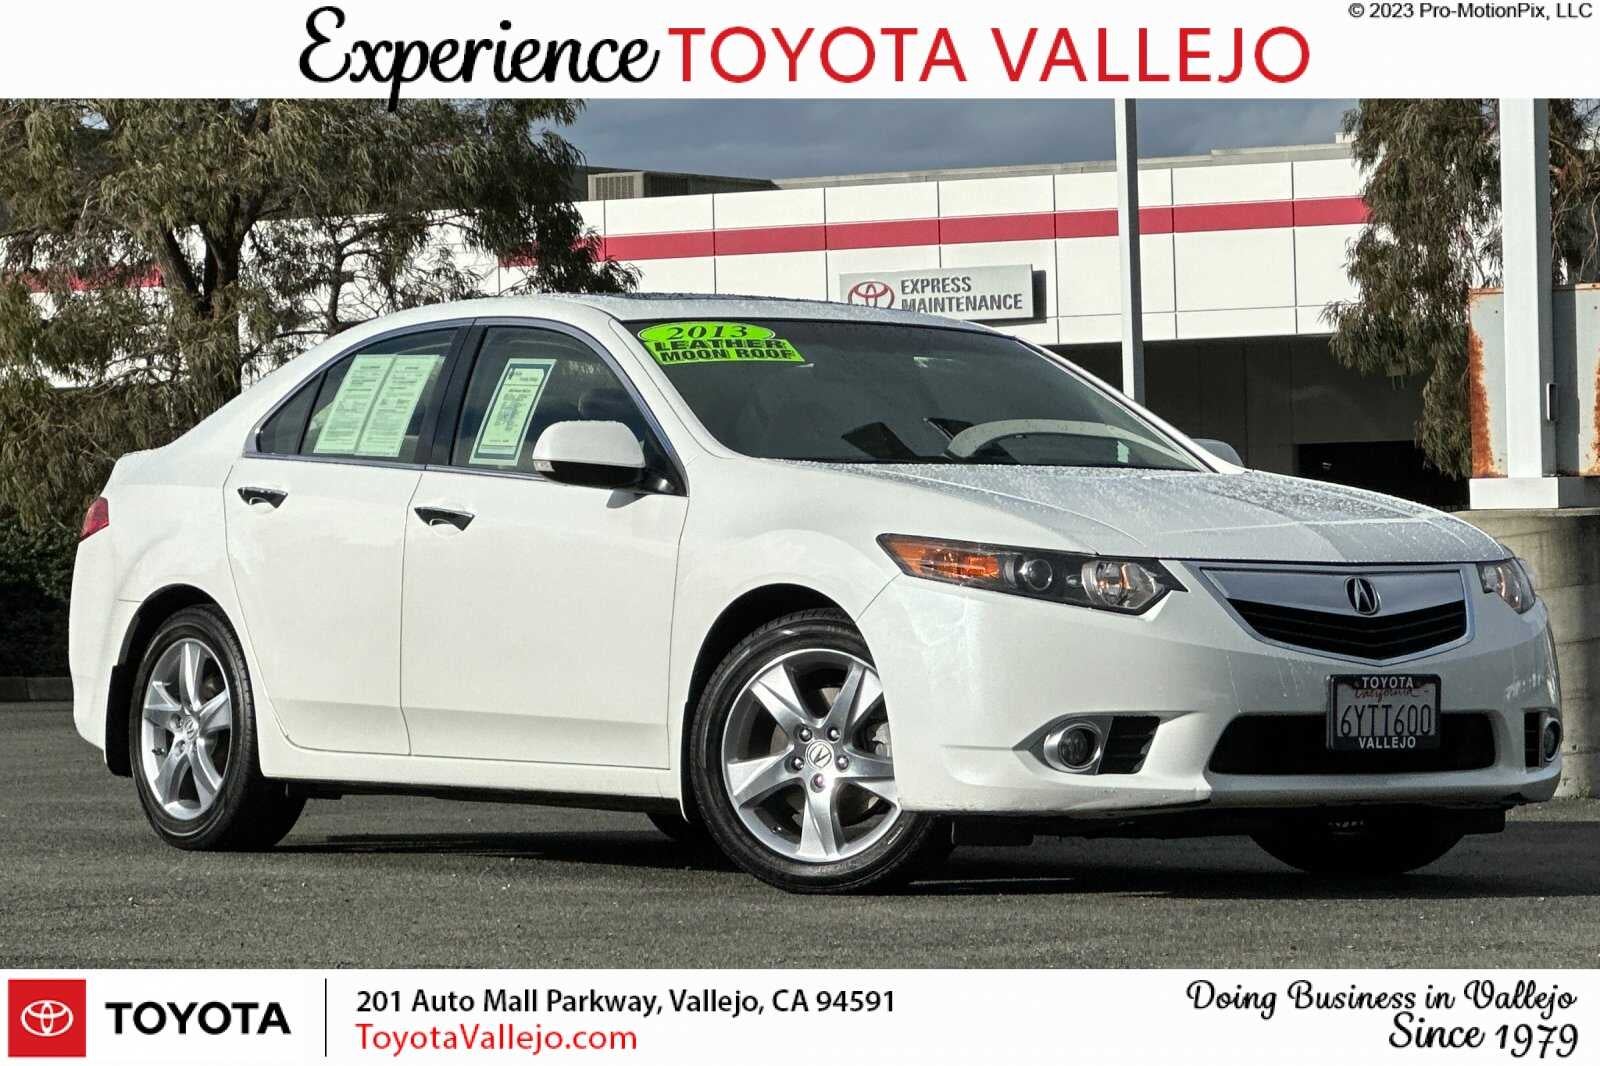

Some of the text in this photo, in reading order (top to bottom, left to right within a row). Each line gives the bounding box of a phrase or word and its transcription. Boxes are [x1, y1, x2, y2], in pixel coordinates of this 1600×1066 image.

[900, 276, 972, 295] EXPRESS
[901, 293, 1023, 313] MAINTENANCE
[667, 325, 748, 340] 2013
[654, 339, 784, 351] LEATHER
[660, 349, 795, 362] MOON ROOF
[1362, 676, 1414, 689] TOYOTA
[1341, 704, 1431, 736] 6YTT600
[1358, 736, 1416, 749] VALLEJO
